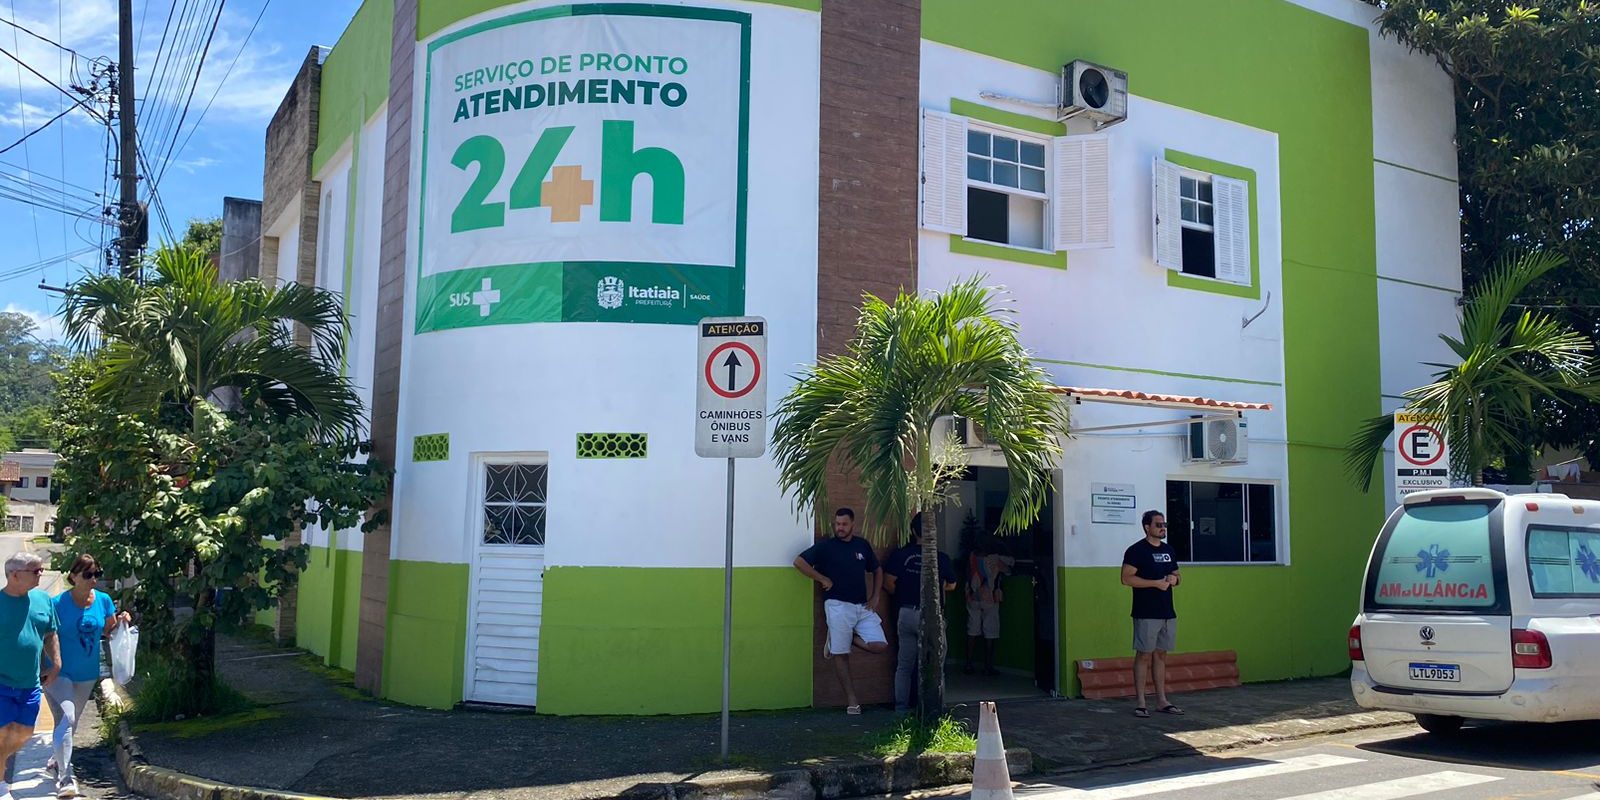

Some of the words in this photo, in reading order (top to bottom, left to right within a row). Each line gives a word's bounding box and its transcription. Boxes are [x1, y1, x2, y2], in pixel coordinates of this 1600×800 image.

[454, 59, 534, 92] SERVIÇO
[540, 54, 572, 75] DE
[580, 53, 689, 75] PRONTO
[453, 79, 688, 123] ATENDIMENTO
[450, 119, 686, 234] 24h
[449, 292, 471, 307] SUS
[628, 285, 680, 299] Itatiaia
[689, 292, 711, 301] SAÚDE
[634, 299, 673, 308] PREFEITURA
[707, 323, 759, 336] ATENÇÃO
[700, 409, 763, 420] CAMINHÕES
[710, 420, 751, 431] ÔNIBUS
[711, 434, 718, 443] E
[721, 434, 749, 443] VANS
[1412, 432, 1430, 458] E
